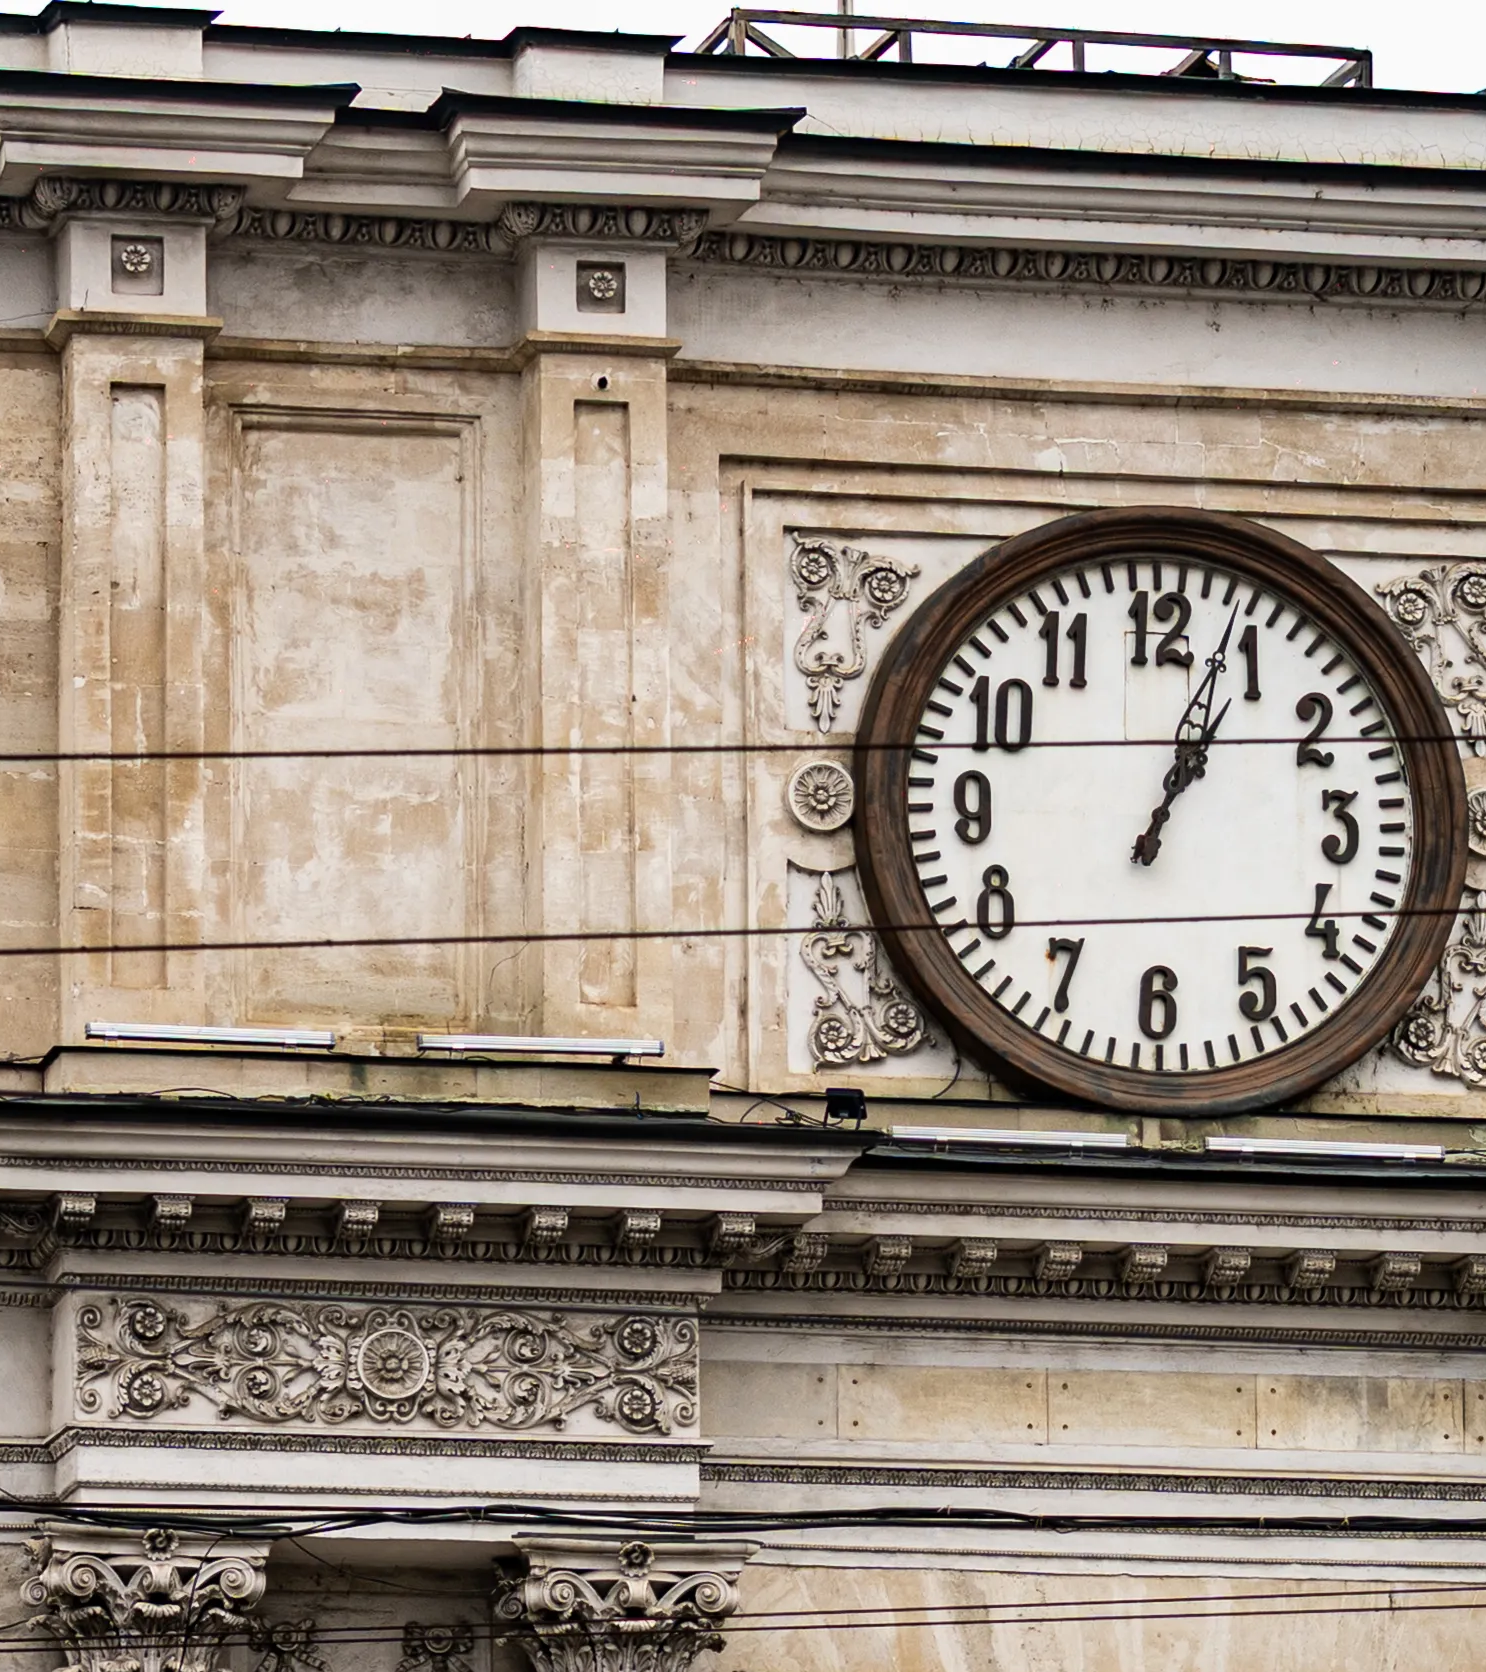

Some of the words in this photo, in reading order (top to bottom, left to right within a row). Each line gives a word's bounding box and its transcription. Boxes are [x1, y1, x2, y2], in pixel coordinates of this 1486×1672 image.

[1039, 611, 1088, 689] 11
[1129, 591, 1193, 667] 12
[1238, 625, 1262, 702] 1
[969, 675, 1033, 752] 10
[1296, 692, 1333, 768] 2
[954, 770, 991, 845] 9
[1322, 790, 1359, 865] 3
[977, 864, 1015, 939] 8
[1305, 883, 1340, 959] 4
[1048, 938, 1084, 1013] 7
[1139, 965, 1178, 1040] 6
[1238, 946, 1276, 1022] 5
